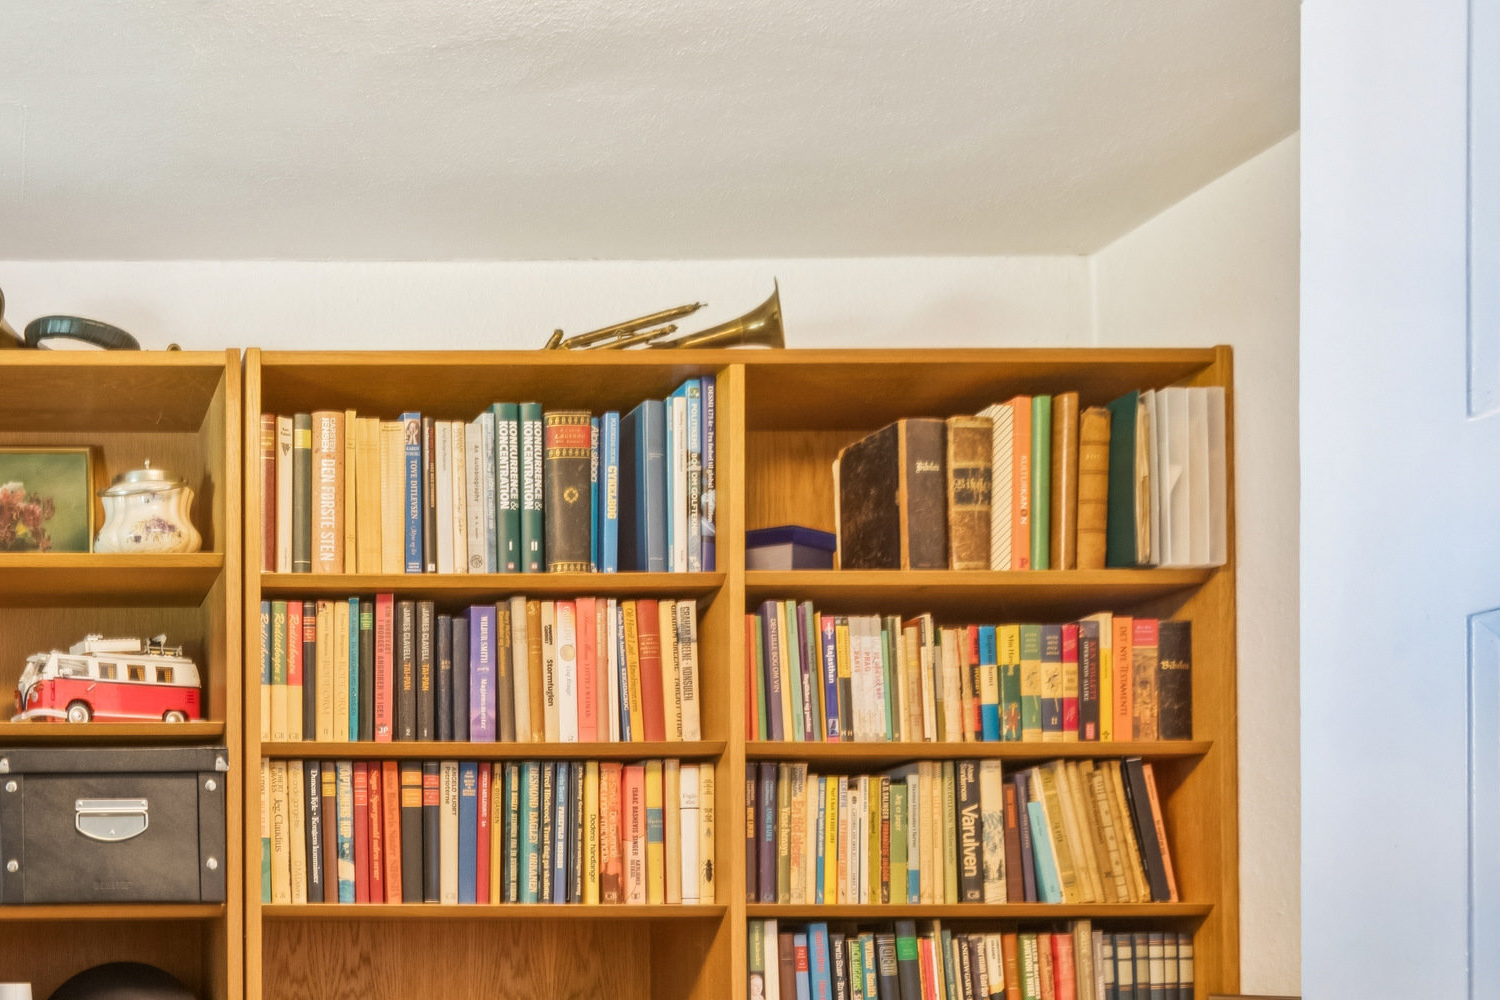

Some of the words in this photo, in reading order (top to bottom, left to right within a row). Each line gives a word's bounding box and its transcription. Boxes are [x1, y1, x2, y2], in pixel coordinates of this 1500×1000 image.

[707, 386, 715, 408] DESMI
[321, 417, 330, 453] JENSEN
[329, 417, 337, 453] CARSTEN
[590, 425, 599, 450] Alpin
[691, 403, 699, 450] POLITIKENS
[320, 458, 336, 483] DEN
[410, 459, 419, 479] TOVE
[498, 421, 509, 511] KONCENTRATION
[509, 421, 519, 500] KONKURRENCE
[523, 421, 534, 511] KONCENTRATION
[533, 421, 542, 500] KONKURRENCE
[690, 453, 699, 470] BOG
[691, 472, 699, 486] OM
[706, 469, 715, 488] global
[1020, 455, 1029, 526] KULTURKANON
[409, 480, 419, 520] DITLEVSEN
[510, 502, 519, 511] &
[534, 502, 542, 511] &
[690, 487, 699, 537] GOLFTEKNIK
[320, 531, 336, 562] STEN
[403, 607, 412, 631] JAMES
[421, 608, 430, 632] JAMES
[480, 615, 489, 641] WILBUR
[679, 606, 692, 641] GRAHAM
[771, 617, 779, 633] DEN
[403, 632, 412, 661] CLAVELL
[421, 633, 430, 661] CLAVELL
[1119, 626, 1128, 643] DET
[480, 642, 489, 664] SMITH
[680, 640, 693, 662] GREENE
[826, 645, 836, 684] Rajasthan
[1082, 640, 1090, 678] OPERATION
[1119, 646, 1128, 663] NYE
[376, 655, 384, 687] ANGRIBER
[403, 663, 412, 691] TAI-PAN
[421, 663, 430, 692] TAI-PAN
[546, 659, 556, 707] Stormfuglen
[682, 666, 694, 702] KONSULEN
[773, 666, 780, 679] OM
[773, 679, 781, 693] VIN
[1119, 664, 1129, 717] TESTAMENTE
[376, 702, 384, 719] IGEN
[405, 729, 412, 737] 2
[310, 769, 319, 796] Duncan
[443, 766, 452, 806] Patrioterne
[528, 767, 539, 809] DESMOND
[543, 767, 552, 788] Alfred
[310, 796, 319, 812] Kyle
[543, 789, 552, 825] Hitchcock
[632, 788, 640, 806] ISAAC
[881, 781, 890, 820] J.D.SALINGER
[528, 811, 539, 845] BAGLEY
[590, 814, 598, 842] Dødens
[632, 806, 640, 834] BASHEVIS
[780, 807, 791, 828] Visse
[274, 814, 284, 853] Claudius
[632, 835, 640, 857] SINGER
[779, 829, 791, 857] hensyn
[961, 803, 980, 878] Varulven
[589, 844, 598, 884] håndlanger
[834, 940, 844, 961] Irwin
[851, 943, 863, 963] JACK
[864, 940, 875, 970] Wilbur
[961, 942, 971, 974] ANDREW
[976, 942, 987, 973] Norman
[1023, 939, 1033, 973] AUKTION
[1031, 939, 1039, 962] HELEN
[835, 960, 844, 979] Shaw
[853, 963, 864, 992] HIGGINS
[866, 972, 877, 998] Smith
[964, 973, 973, 996] GARVE
[979, 973, 989, 998] Garbo
[1026, 978, 1035, 997] WIEN
